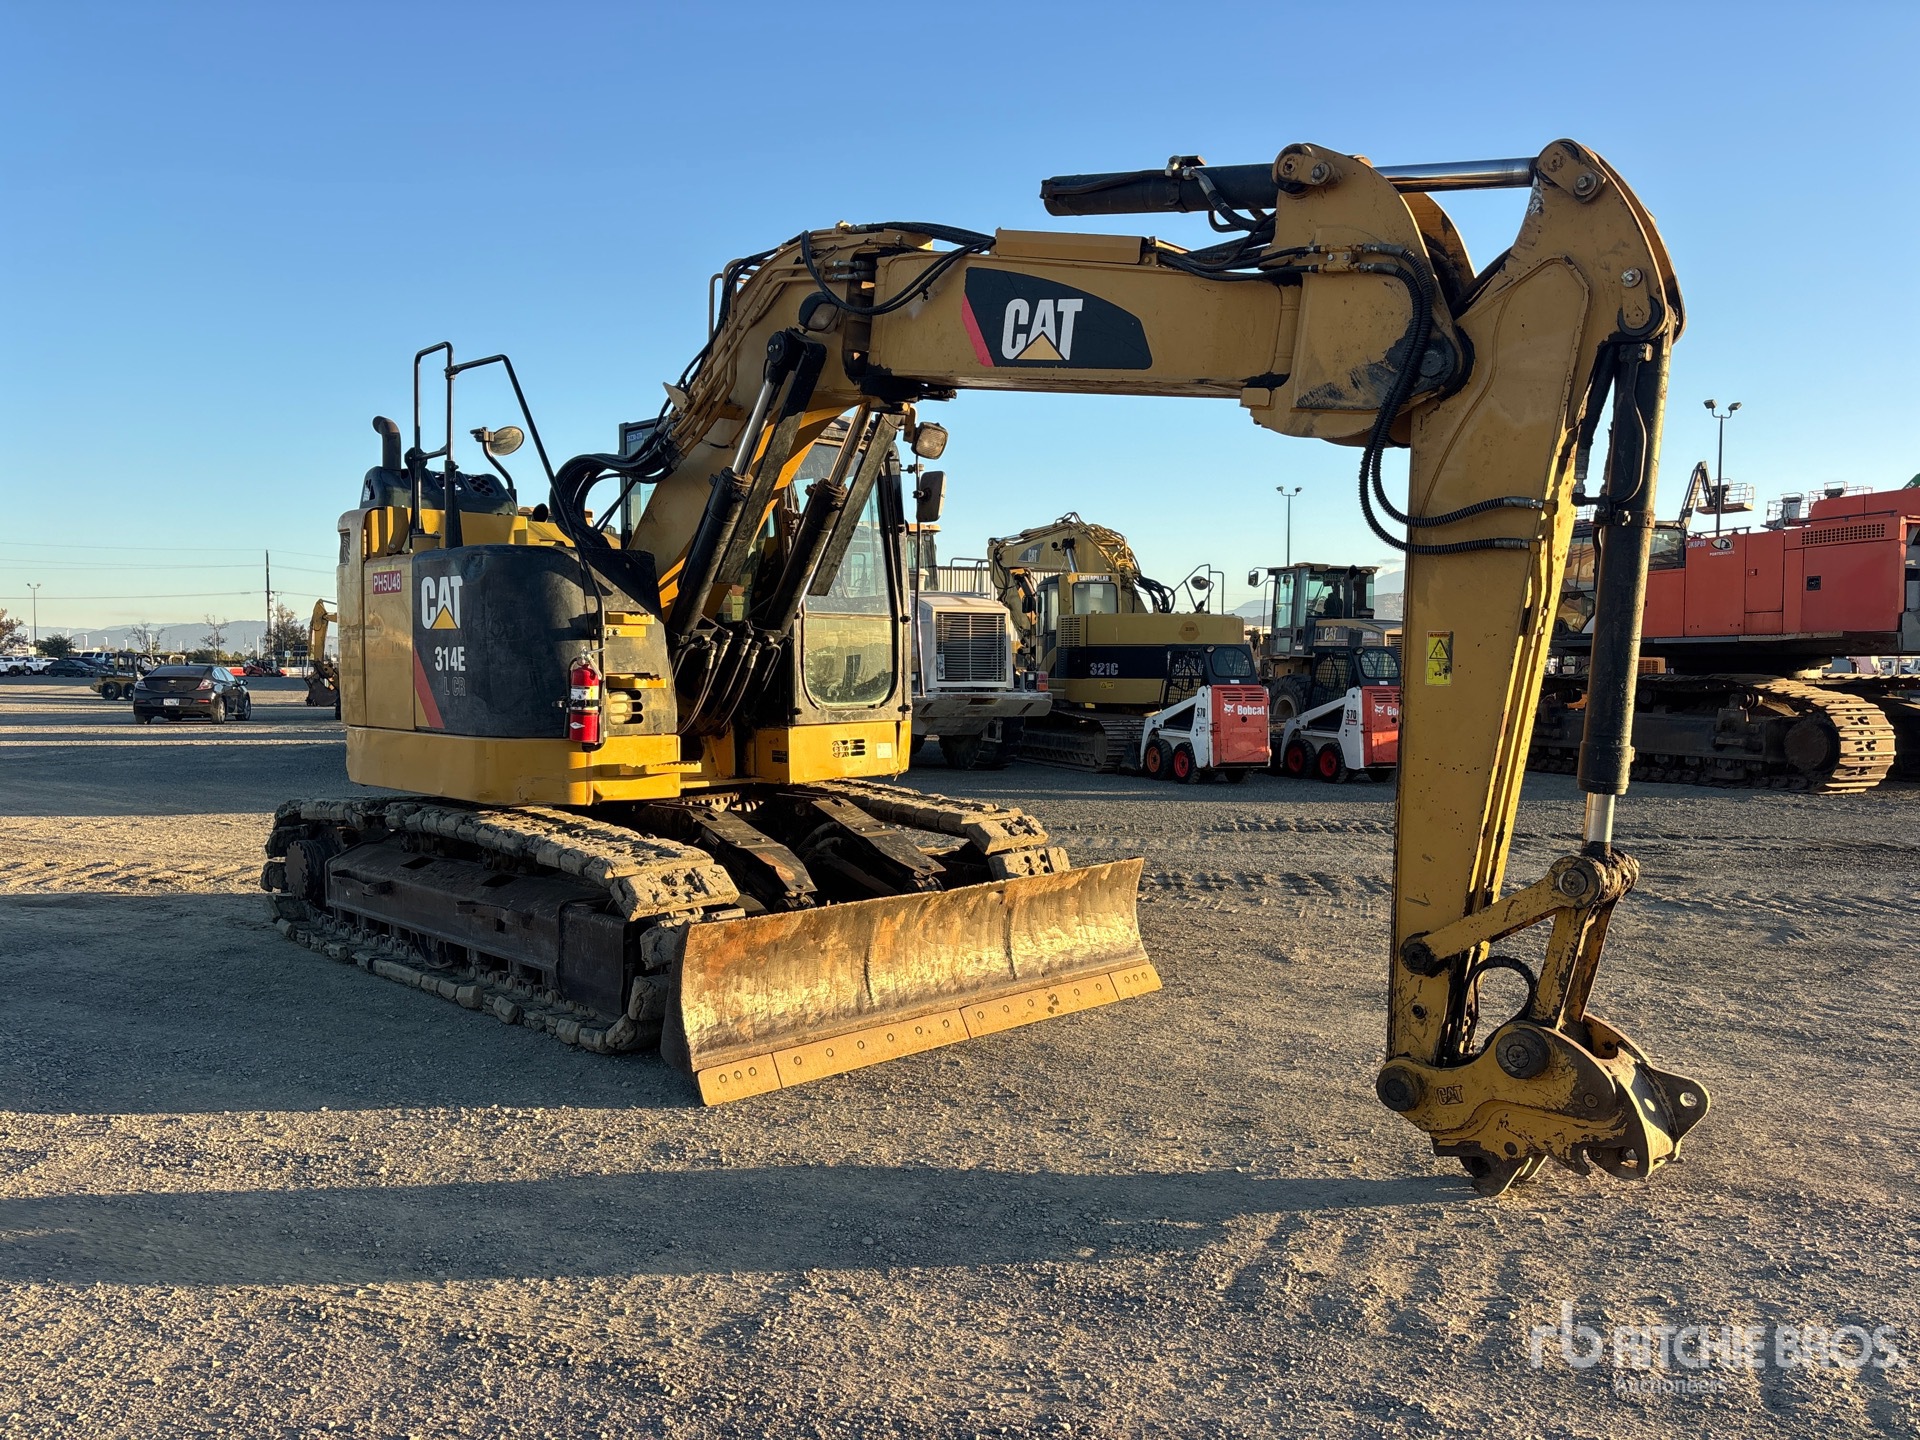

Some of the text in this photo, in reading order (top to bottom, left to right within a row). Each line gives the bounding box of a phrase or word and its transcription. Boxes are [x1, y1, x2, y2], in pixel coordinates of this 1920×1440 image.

[1001, 298, 1083, 360] CAT
[1028, 549, 1038, 562] CAT
[373, 573, 400, 592] PH5U48
[421, 575, 463, 630] CAT
[1324, 627, 1338, 641] CAT
[434, 646, 466, 672] 314E
[1089, 662, 1119, 676] 321C
[444, 677, 466, 697] L CR
[1196, 707, 1206, 718] S70
[1237, 705, 1265, 716] Bobcat
[1346, 709, 1357, 720] S70
[1437, 1085, 1463, 1105] CAT
